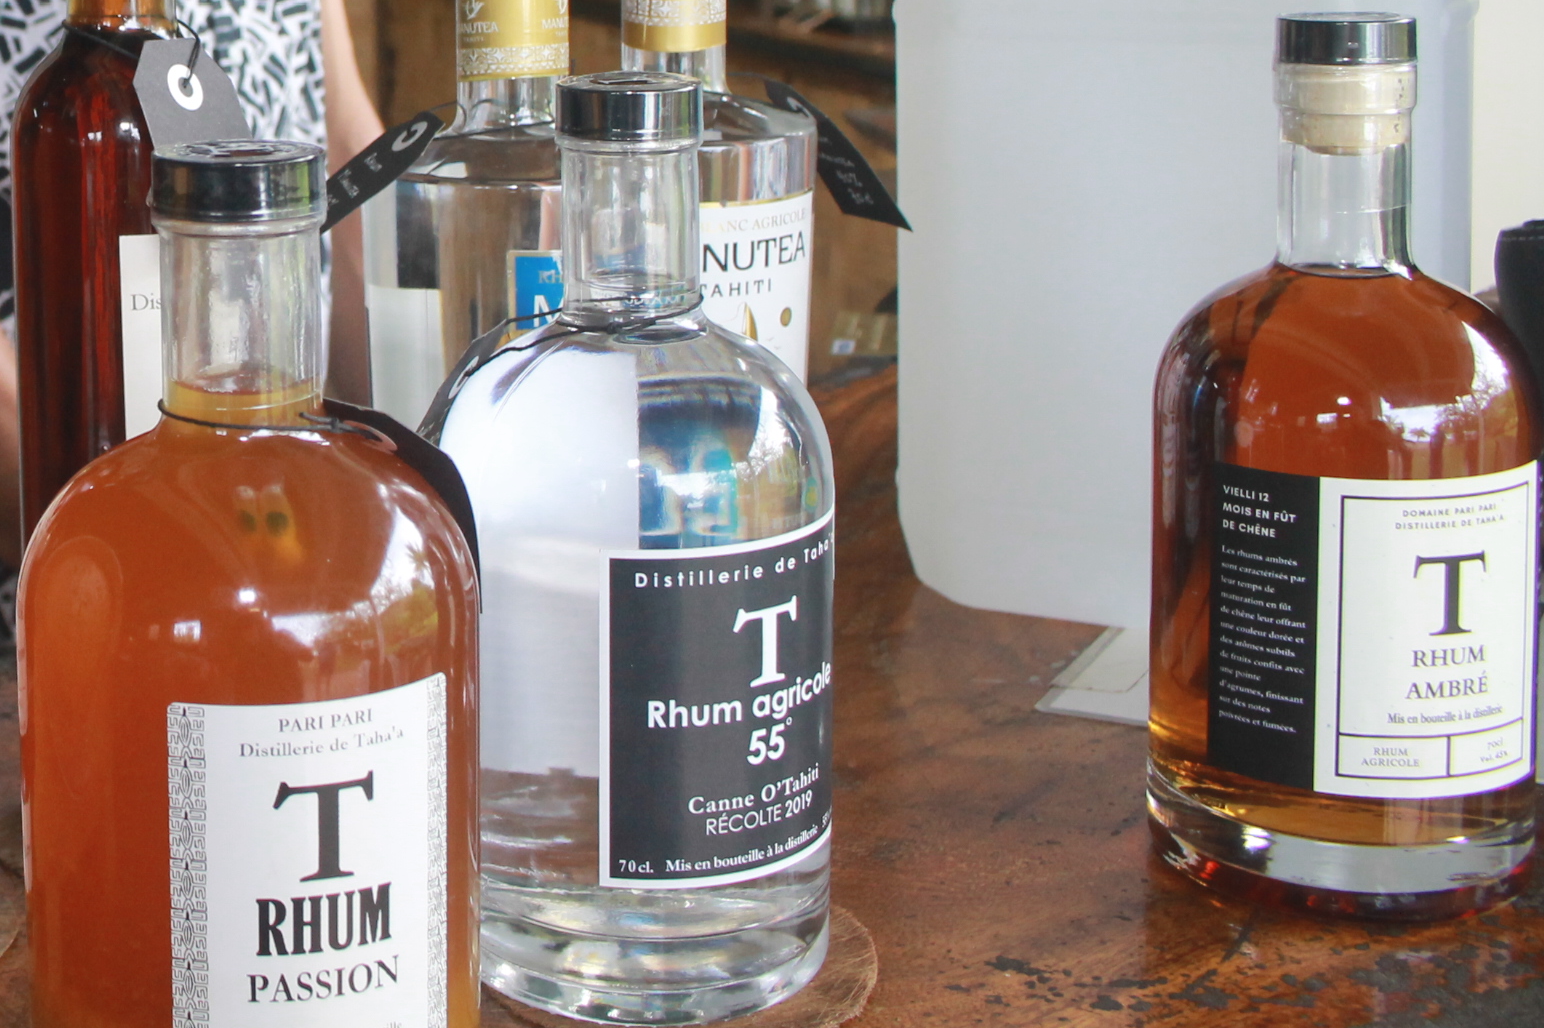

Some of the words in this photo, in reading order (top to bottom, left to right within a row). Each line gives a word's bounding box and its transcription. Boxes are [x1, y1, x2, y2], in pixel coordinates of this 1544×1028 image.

[752, 208, 807, 230] AGRICOLE
[702, 230, 806, 273] NUTEA
[1223, 485, 1255, 500] VIELLI
[1259, 492, 1270, 502] 12
[1223, 502, 1252, 516] MOIS
[1255, 509, 1270, 520] EN
[1274, 510, 1297, 523] FÛT
[1402, 508, 1450, 517] DOMAINE
[1454, 506, 1474, 515] PARI
[1478, 503, 1496, 512] PARI
[1223, 519, 1235, 530] DE
[1239, 523, 1276, 538] CHÊNE
[1395, 520, 1456, 530] DISTILLERIE
[1461, 519, 1472, 527] DE
[1221, 545, 1235, 555] Les
[1237, 549, 1263, 561] rhums
[635, 564, 764, 588] Distillerie
[775, 556, 797, 574] de
[1290, 575, 1306, 584] par
[1264, 585, 1275, 594] de
[1413, 550, 1487, 636] T
[1220, 605, 1229, 614] de
[1275, 617, 1306, 629] offrant
[1266, 602, 1277, 611] en
[732, 594, 797, 688] T
[1236, 625, 1267, 637] couleur
[1411, 645, 1486, 668] RHUM
[647, 699, 743, 729] Rhum
[751, 661, 831, 721] agricole
[1405, 670, 1488, 700] AMBRÉ
[278, 716, 323, 733] PARI
[331, 708, 373, 728] PARI
[1387, 713, 1405, 723] Mis
[1407, 715, 1418, 723] en
[1420, 711, 1456, 723] bouteille
[239, 737, 323, 758] Distillerie
[330, 737, 348, 752] de
[353, 725, 404, 749] Taha'a
[1373, 747, 1408, 756] RHUM
[1361, 758, 1419, 767] AGRICOLE
[688, 794, 755, 816] Canne
[705, 804, 782, 836] RÉCOLTE
[784, 789, 813, 819] 2019
[273, 770, 374, 883] T
[665, 859, 691, 872] Mis
[695, 860, 711, 871] en
[714, 848, 765, 868] bouteille
[774, 842, 784, 855] la
[256, 881, 392, 956] RHUM
[246, 954, 399, 1003] PASSION
